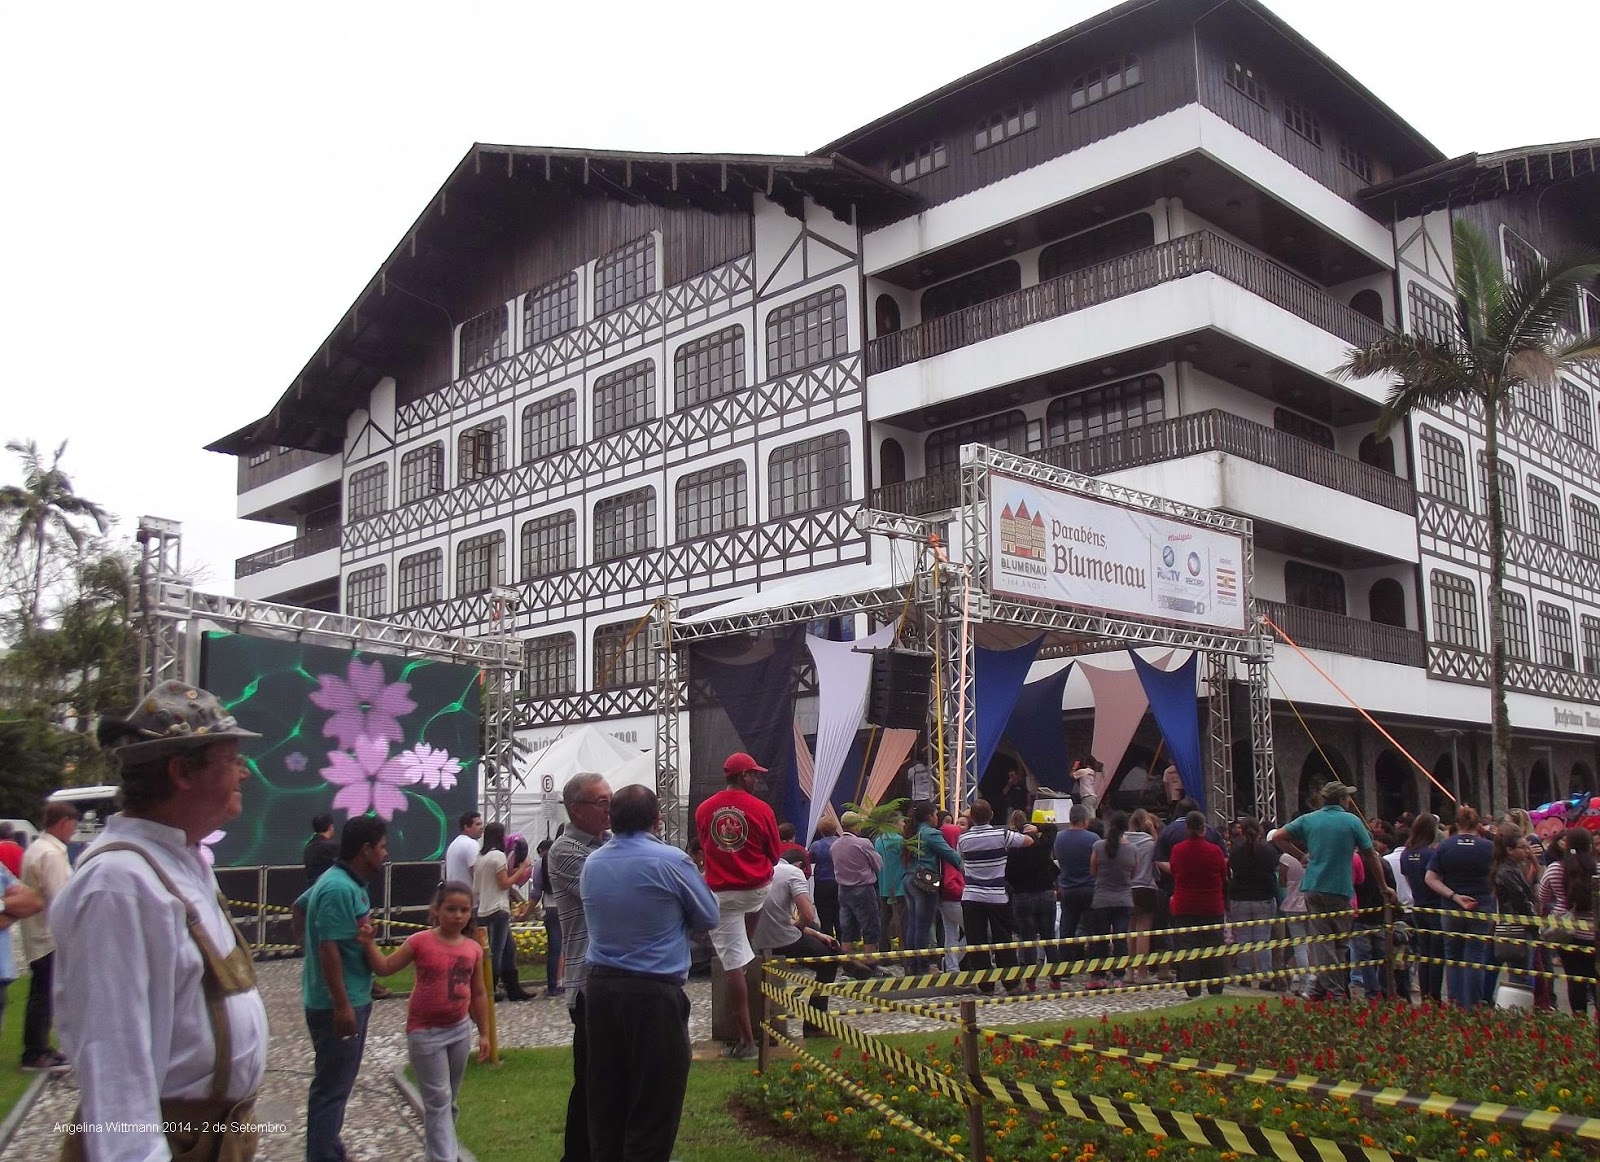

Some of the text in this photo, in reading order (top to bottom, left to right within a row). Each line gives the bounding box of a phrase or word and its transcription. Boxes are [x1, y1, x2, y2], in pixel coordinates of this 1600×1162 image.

[1052, 518, 1108, 550] Parabéns,
[1001, 557, 1047, 576] BLUMENAU
[1052, 543, 1147, 590] Blumenau
[1022, 579, 1041, 590] ANOS
